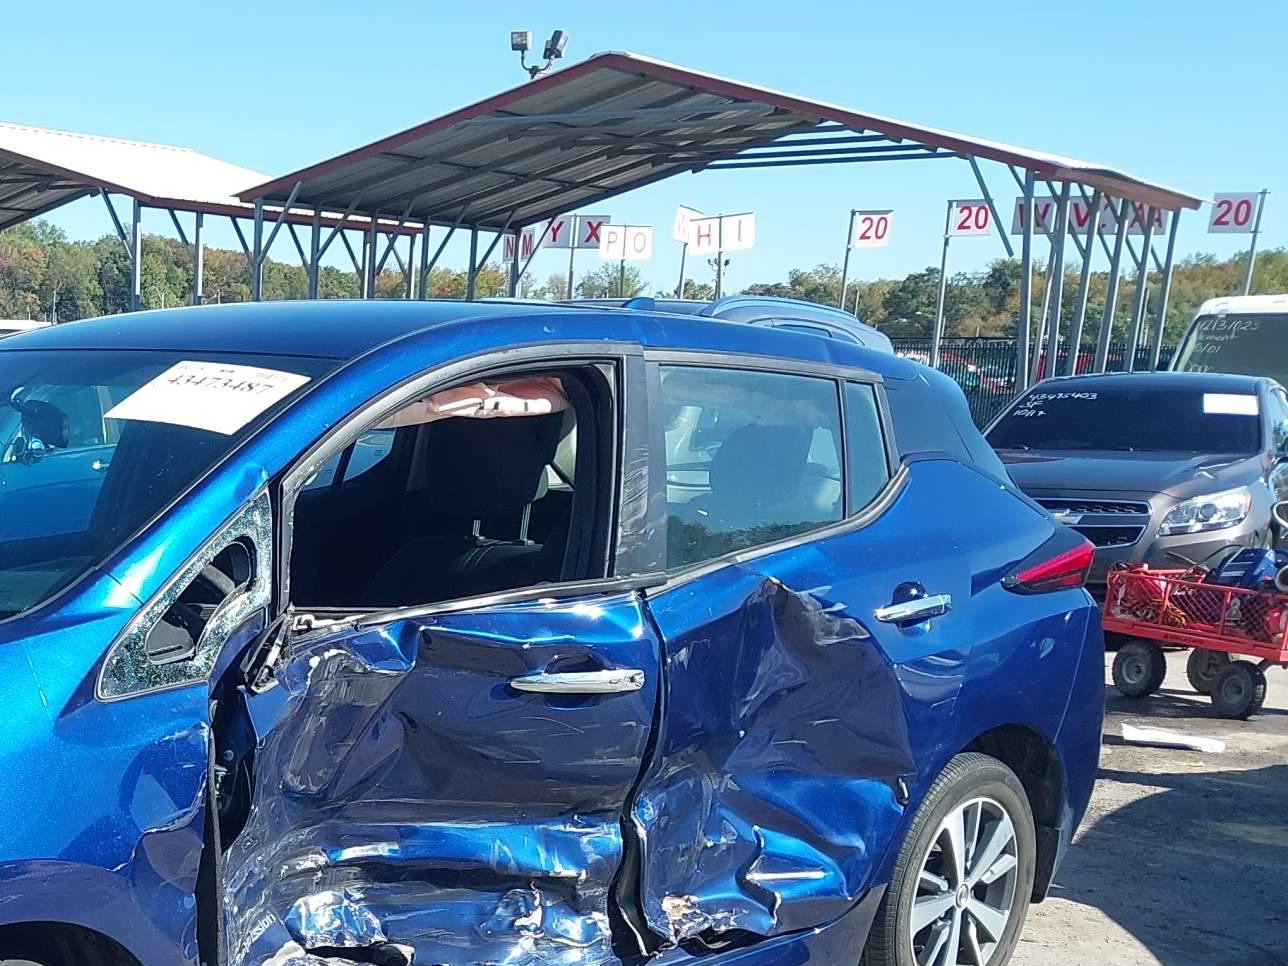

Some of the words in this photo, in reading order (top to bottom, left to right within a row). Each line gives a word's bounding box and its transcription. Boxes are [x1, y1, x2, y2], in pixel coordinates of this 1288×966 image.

[957, 205, 989, 230] 20
[1212, 199, 1252, 226] 20
[548, 221, 565, 242] Y
[584, 221, 603, 243] X
[697, 223, 711, 247] H
[737, 219, 742, 241] I
[859, 216, 888, 240] 20
[522, 233, 532, 256] M
[606, 231, 618, 252] P
[633, 231, 646, 253] O
